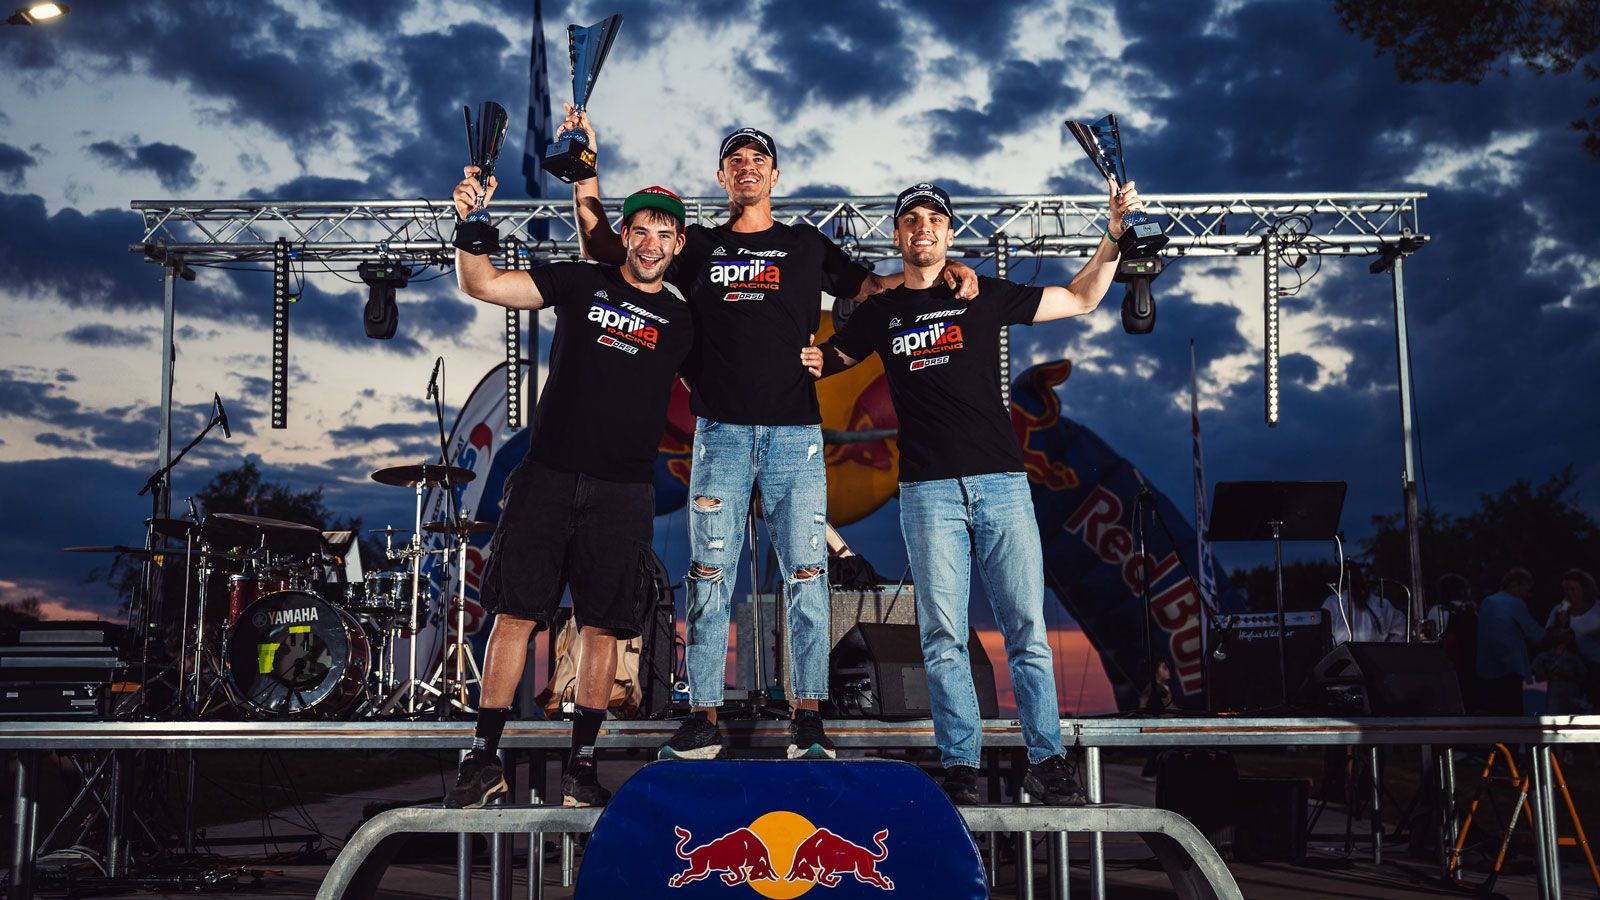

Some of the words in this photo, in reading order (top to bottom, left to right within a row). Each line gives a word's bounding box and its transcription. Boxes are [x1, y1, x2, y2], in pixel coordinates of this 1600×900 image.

[710, 259, 780, 287] aprilia
[729, 282, 780, 290] RACING
[587, 305, 659, 344] aprilia
[607, 327, 657, 350] RACING
[892, 321, 964, 356] aprilia
[912, 342, 964, 357] RACING
[1062, 486, 1180, 598] Red
[1151, 575, 1202, 695] Bull
[268, 606, 319, 625] YAMAHA
